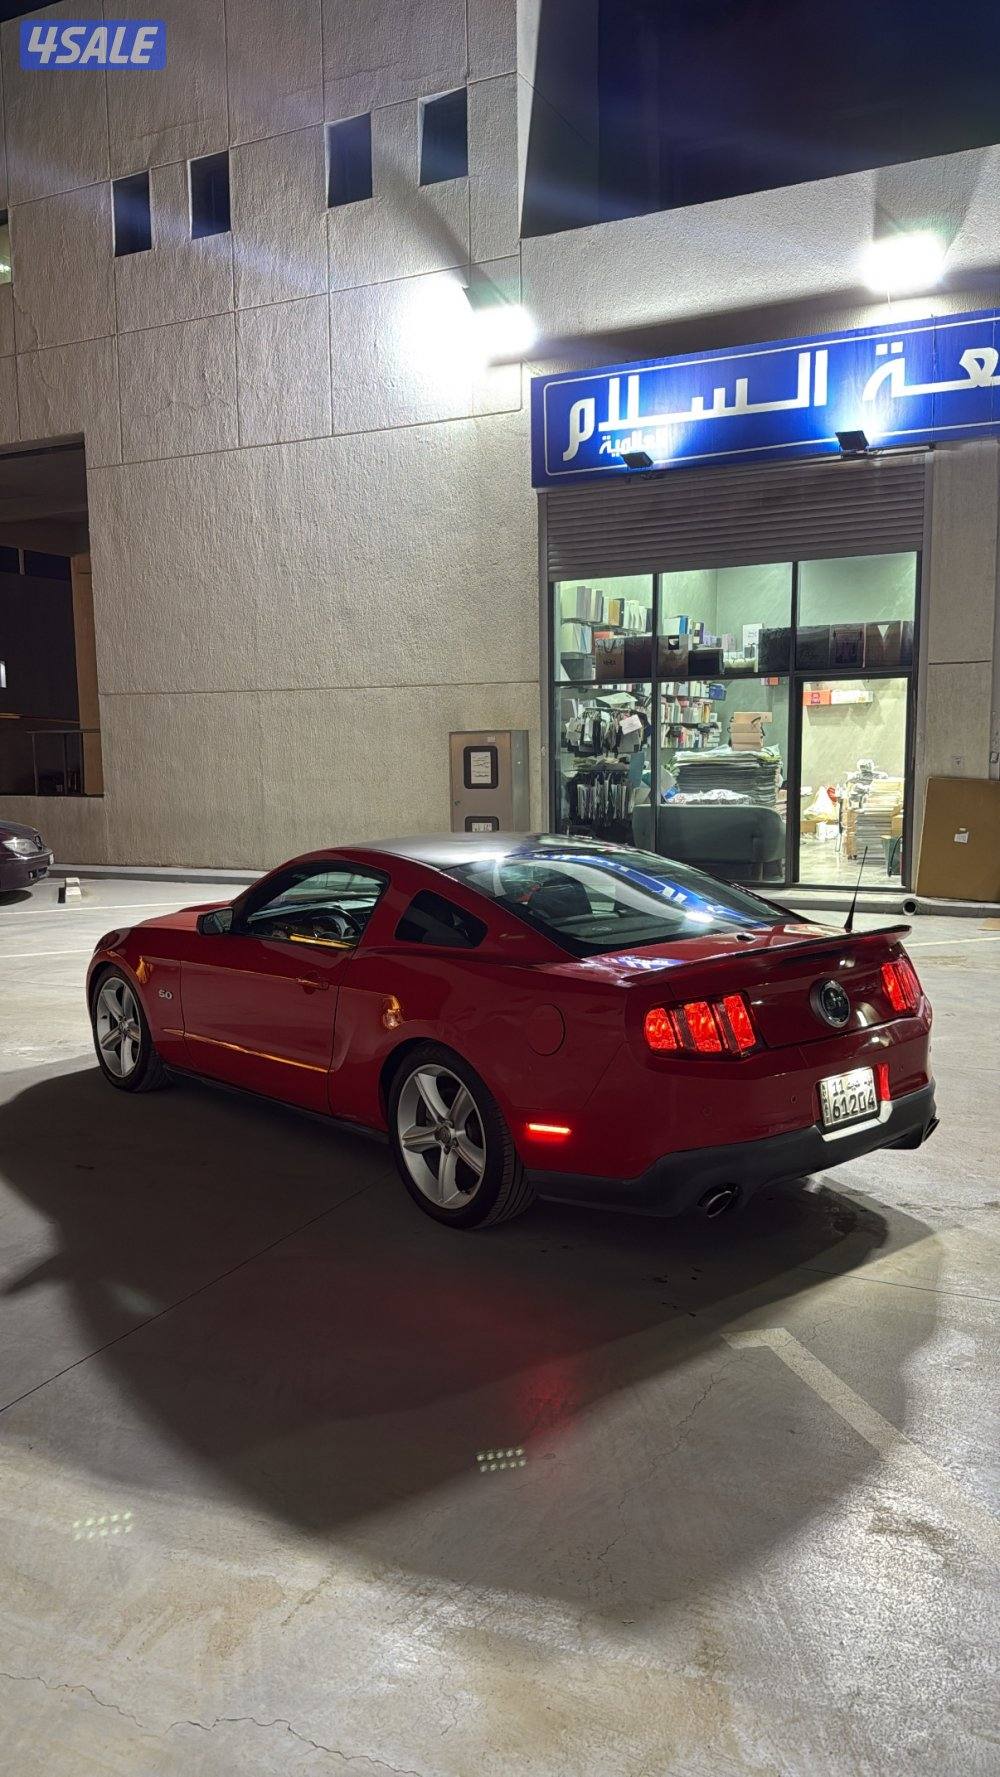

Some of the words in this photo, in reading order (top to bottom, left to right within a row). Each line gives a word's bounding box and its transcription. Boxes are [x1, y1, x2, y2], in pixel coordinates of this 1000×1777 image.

[861, 341, 1000, 402] عة
[562, 349, 828, 461] السلام
[832, 1079, 845, 1097] 11
[832, 1088, 876, 1119] 61204
